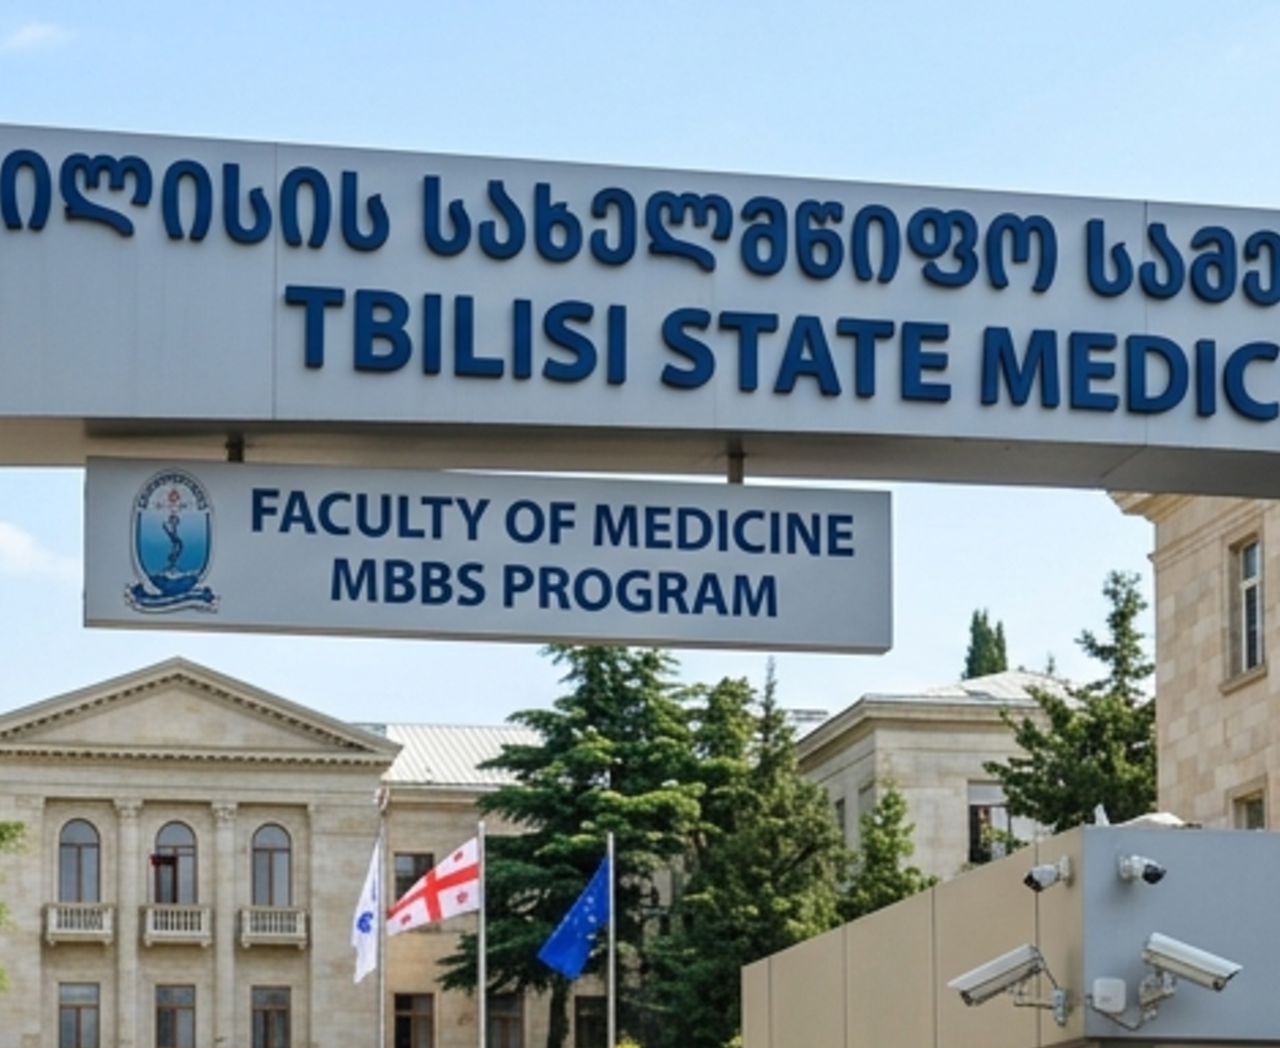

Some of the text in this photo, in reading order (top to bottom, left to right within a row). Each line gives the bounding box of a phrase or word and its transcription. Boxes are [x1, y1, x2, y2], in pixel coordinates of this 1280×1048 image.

[421, 174, 1058, 292] სახელმწიფო
[284, 285, 626, 387] TBILISI
[660, 308, 951, 405] STATE
[250, 487, 490, 541] FACULTY
[505, 499, 576, 545] OF
[593, 503, 855, 558] MEDICINE
[330, 558, 778, 618] MBBS PROGRAM
